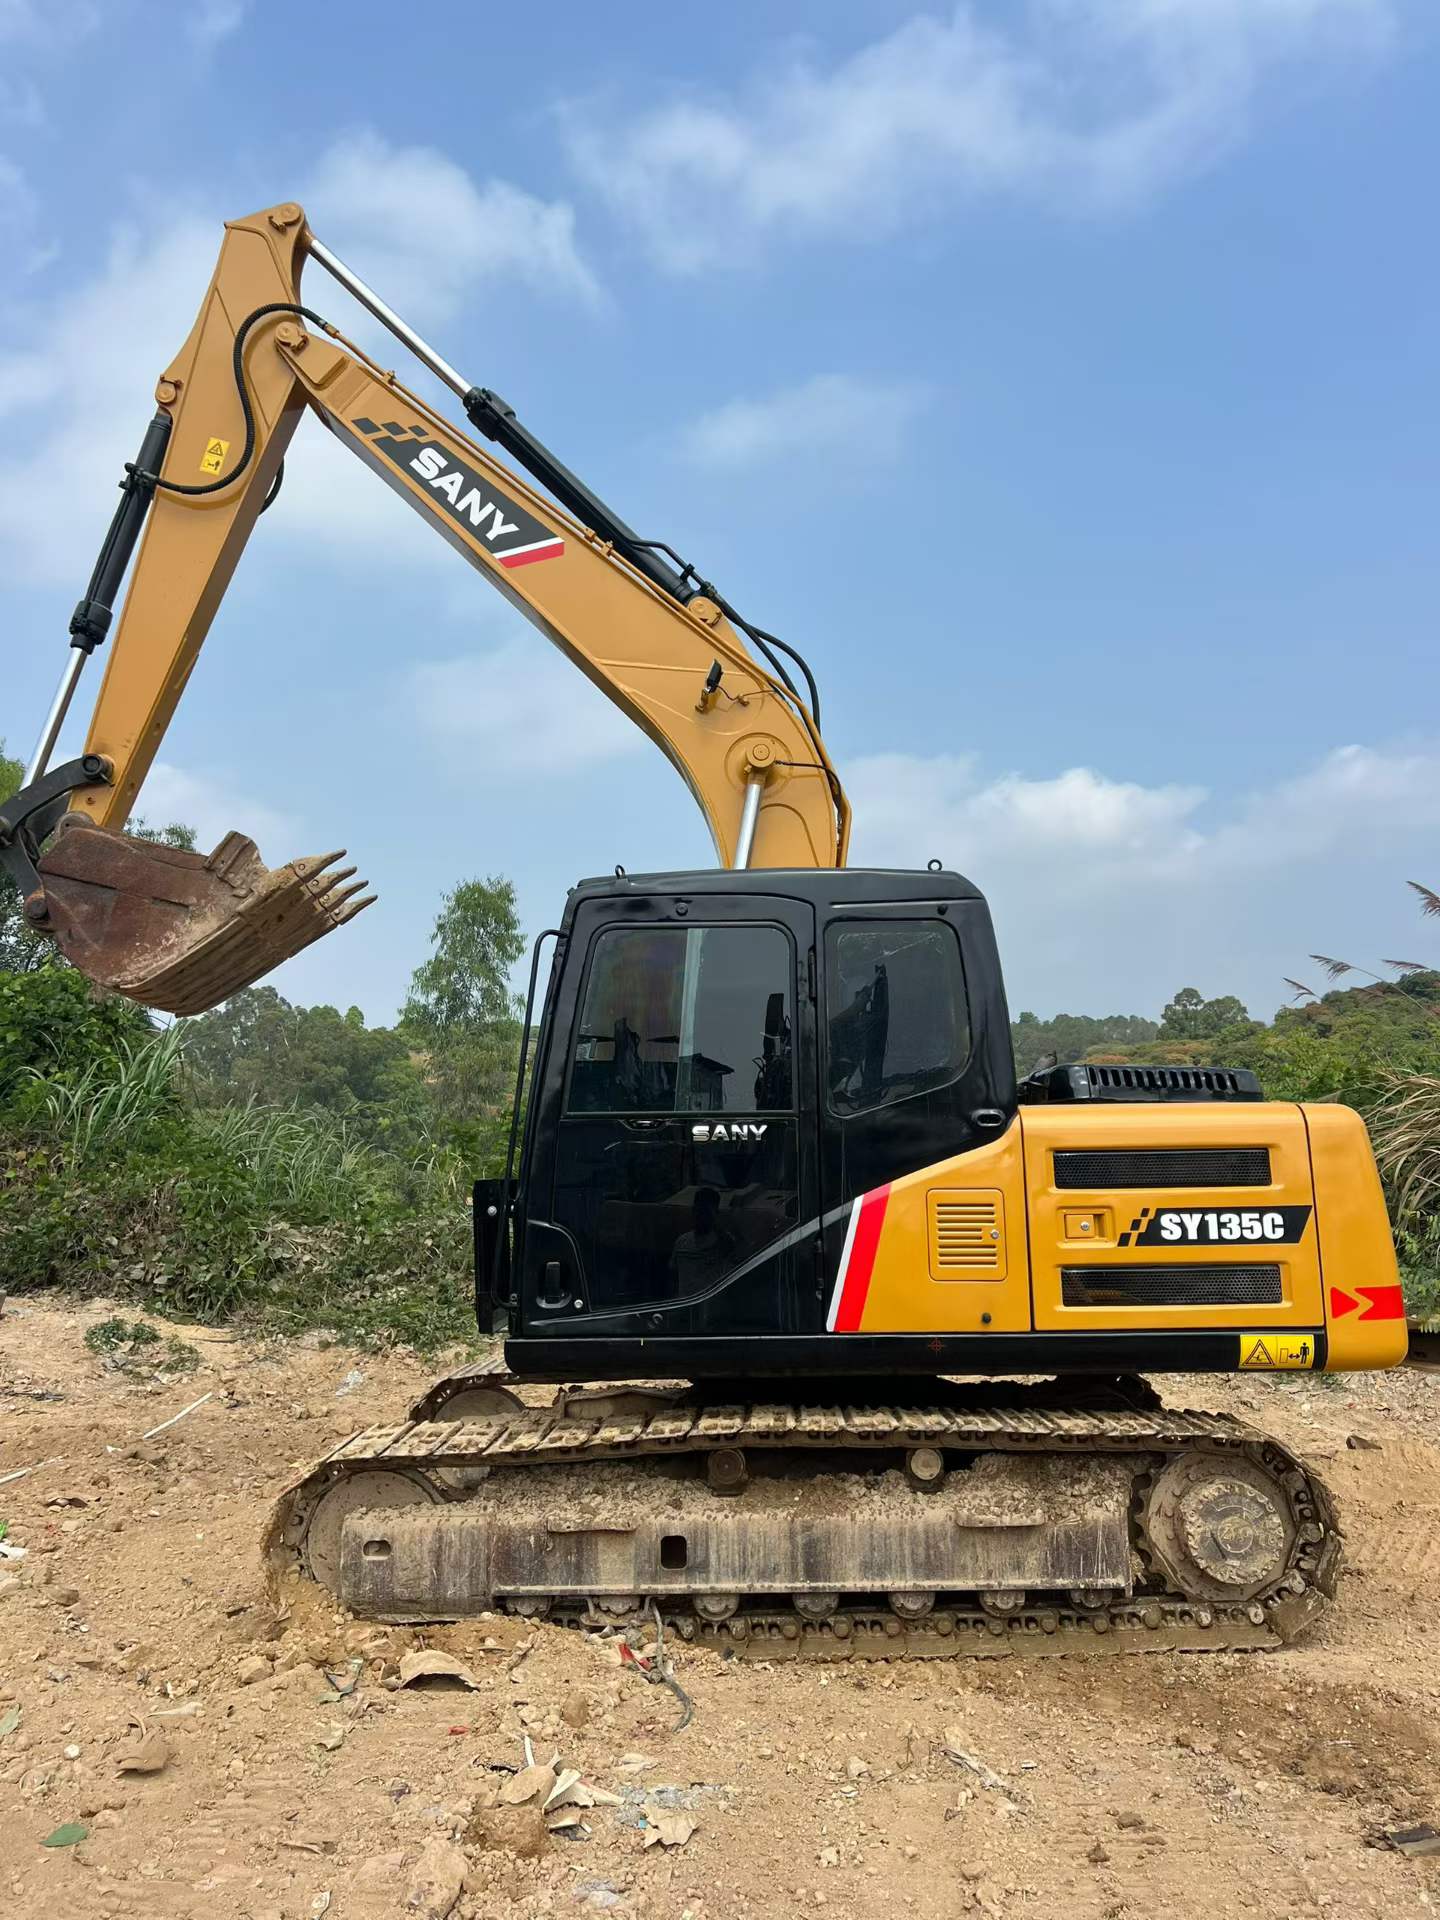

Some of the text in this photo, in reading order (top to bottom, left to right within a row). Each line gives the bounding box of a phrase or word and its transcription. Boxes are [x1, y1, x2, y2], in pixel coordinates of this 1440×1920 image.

[409, 447, 520, 541] SANY
[692, 1124, 768, 1141] SANY
[1160, 1213, 1284, 1240] SY135C
